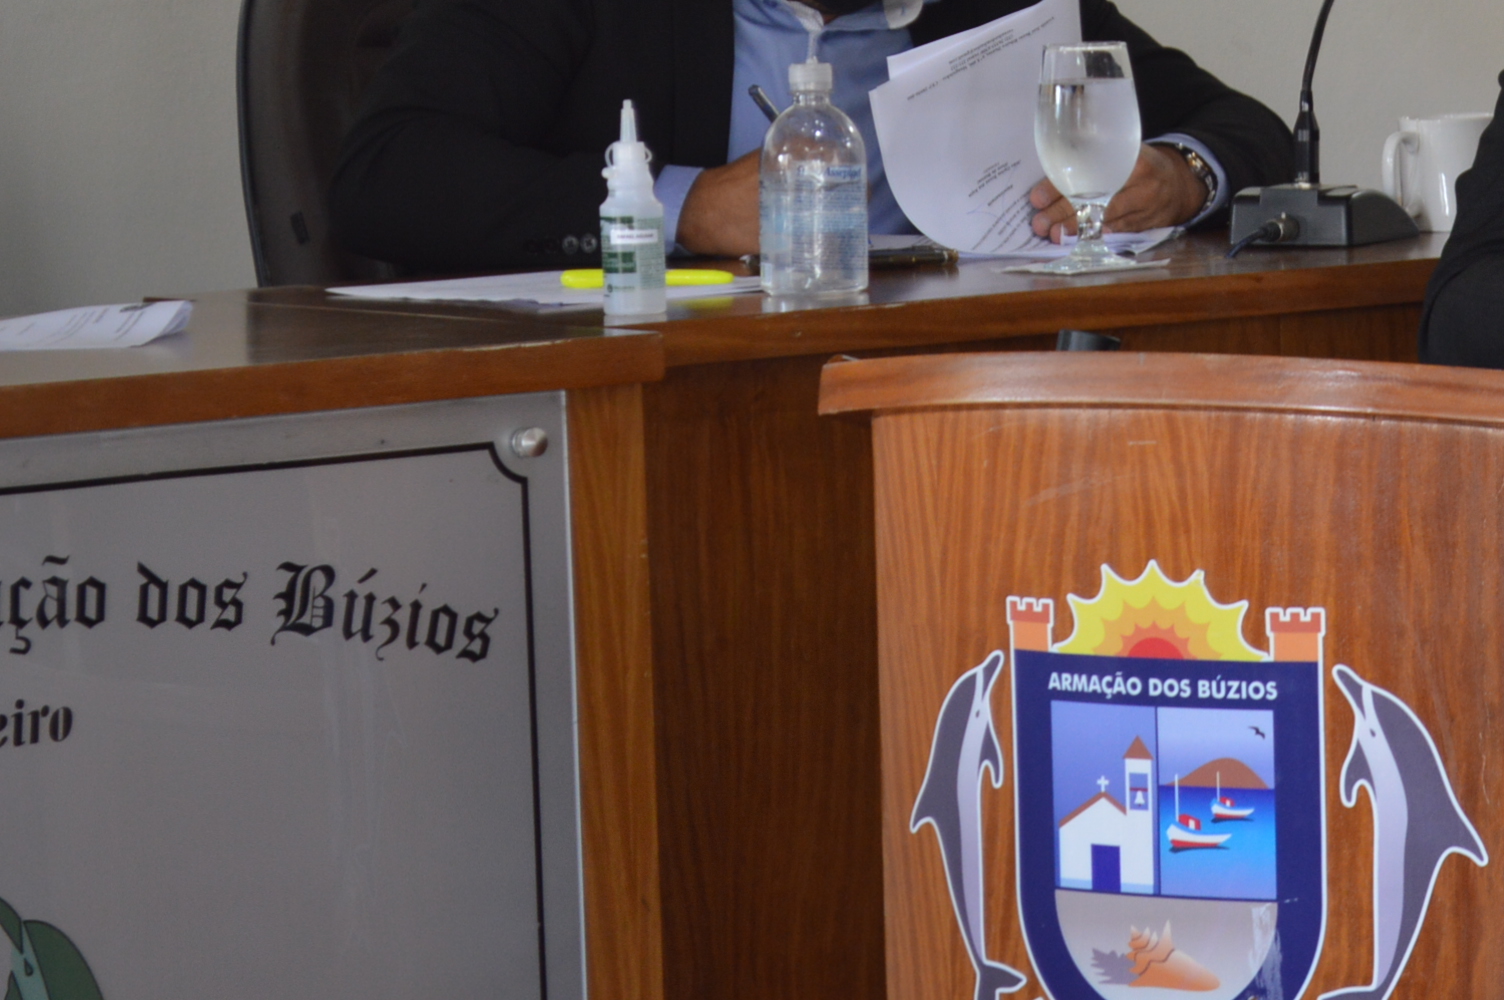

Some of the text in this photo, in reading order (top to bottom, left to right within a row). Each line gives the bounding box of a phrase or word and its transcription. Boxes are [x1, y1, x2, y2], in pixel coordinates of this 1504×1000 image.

[0, 555, 499, 662] ção dos Búzios
[1048, 671, 1278, 701] ARMAÇÃO DOS BÚZIOS
